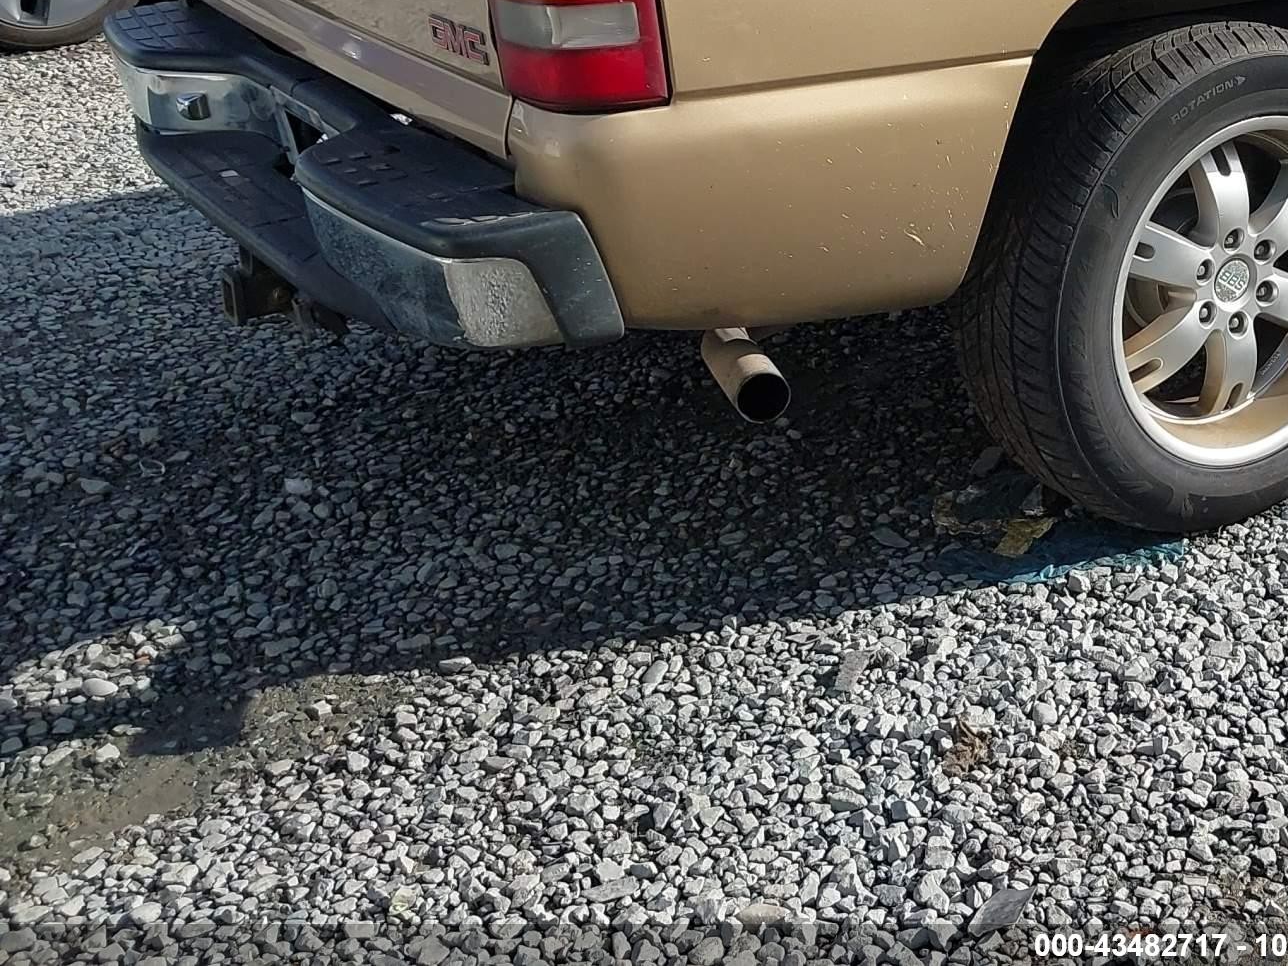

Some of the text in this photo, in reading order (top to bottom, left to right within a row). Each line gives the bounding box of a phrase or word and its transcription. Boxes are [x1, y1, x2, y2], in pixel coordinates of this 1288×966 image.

[428, 14, 489, 66] GMC
[1170, 79, 1234, 125] ROTATION
[1219, 270, 1246, 290] BBS
